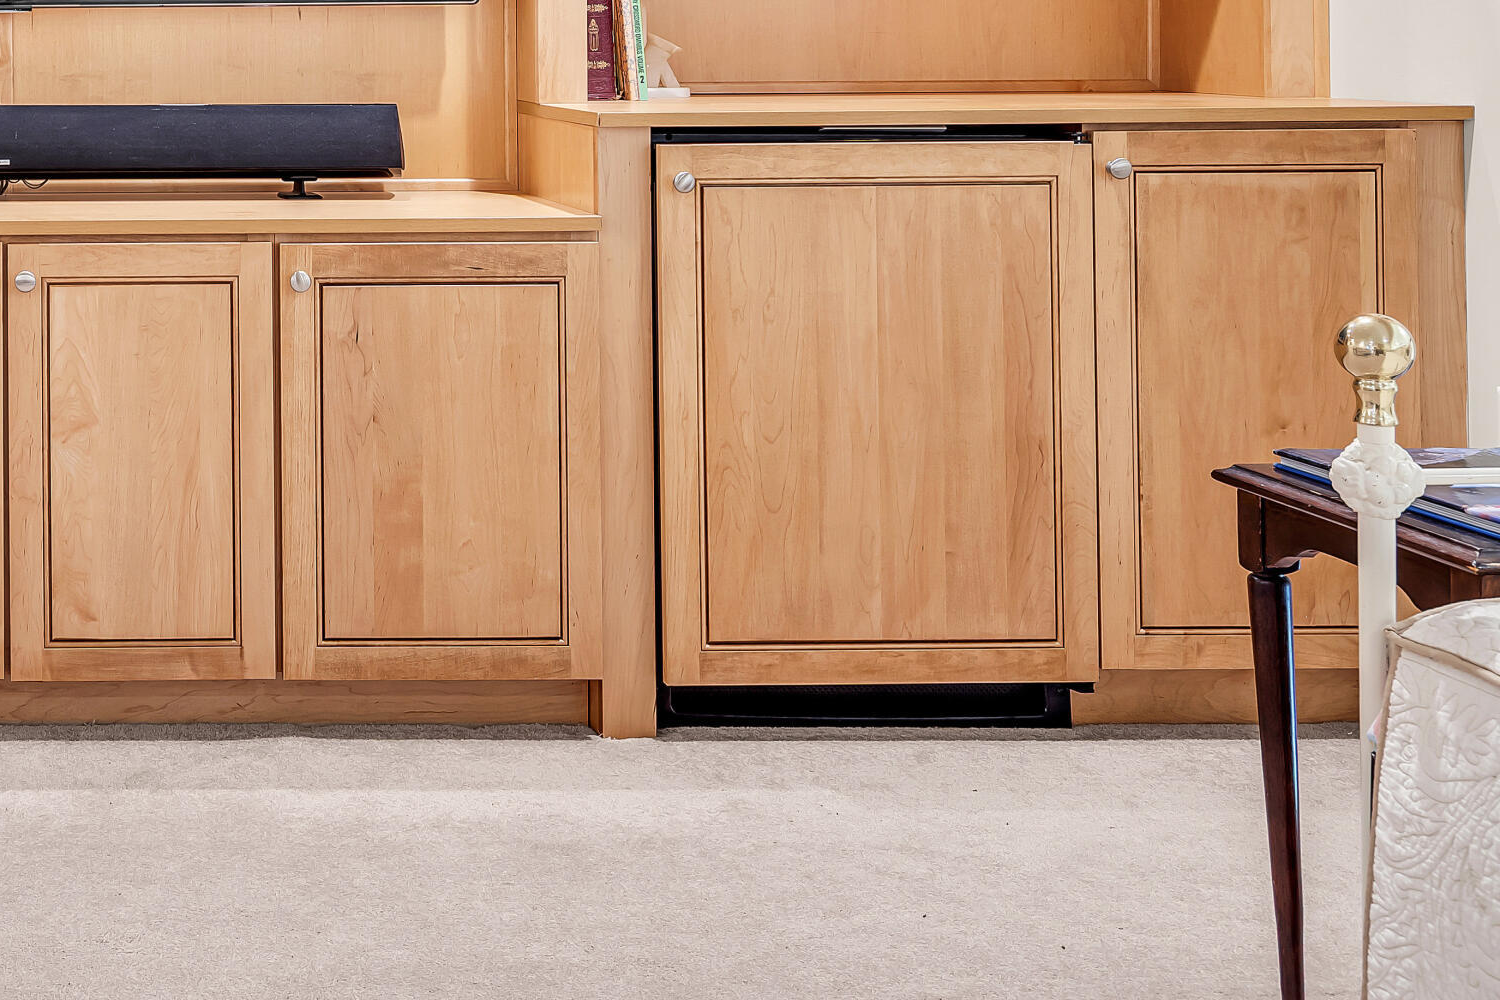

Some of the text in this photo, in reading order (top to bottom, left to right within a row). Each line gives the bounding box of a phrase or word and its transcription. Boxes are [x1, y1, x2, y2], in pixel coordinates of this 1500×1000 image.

[634, 34, 643, 55] OMNIBUS
[636, 56, 644, 74] VOLUME
[640, 75, 645, 84] 2
